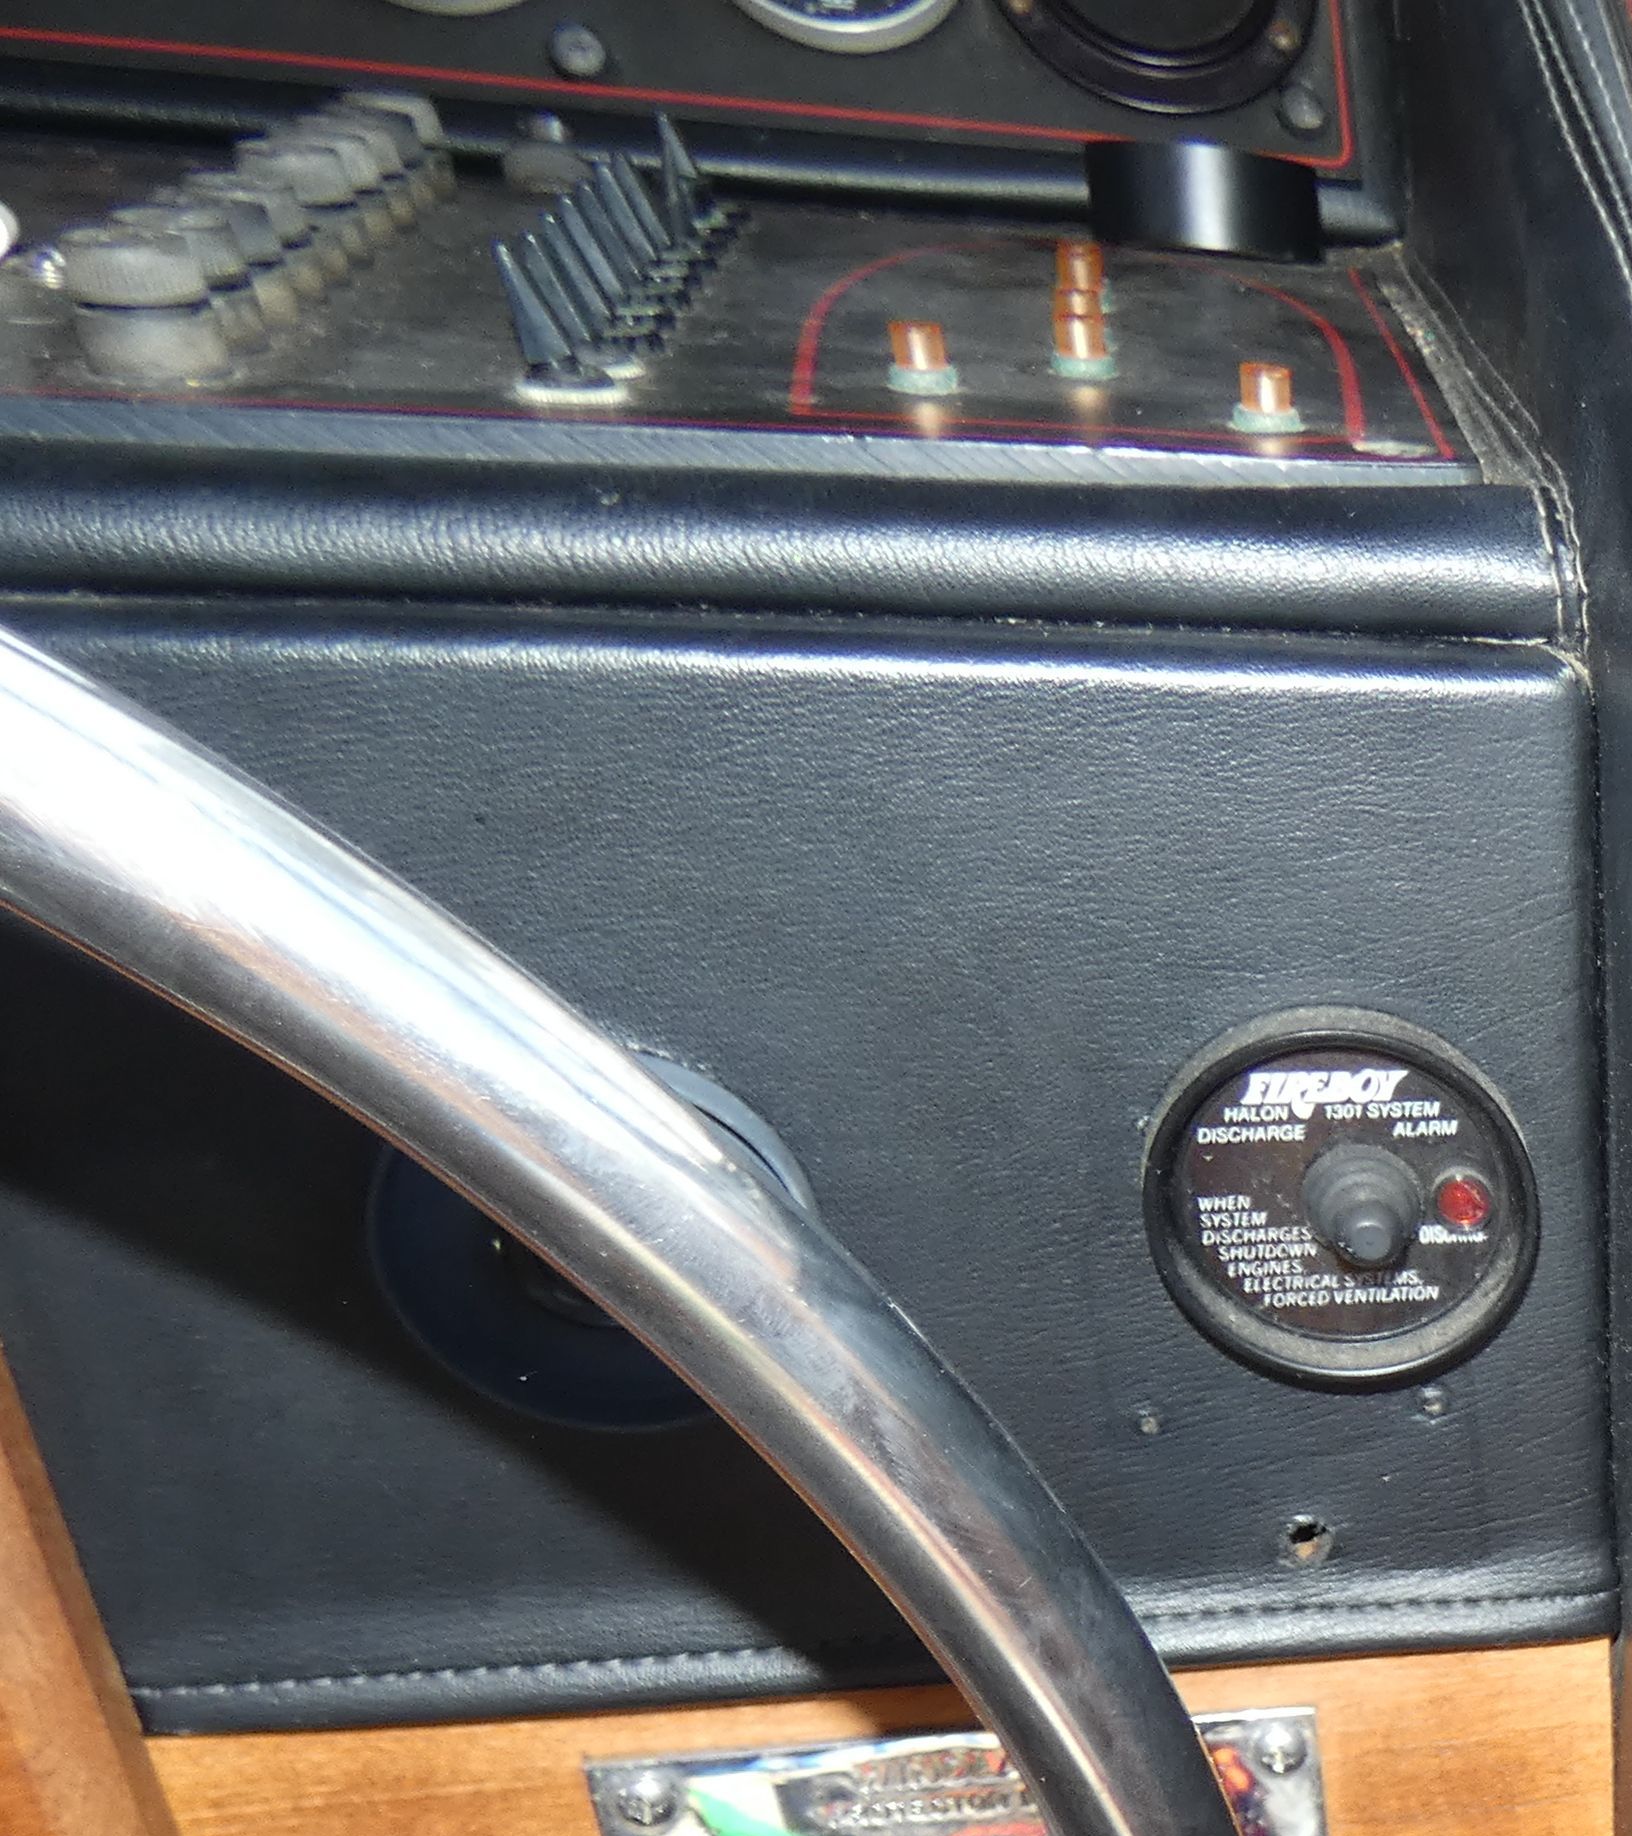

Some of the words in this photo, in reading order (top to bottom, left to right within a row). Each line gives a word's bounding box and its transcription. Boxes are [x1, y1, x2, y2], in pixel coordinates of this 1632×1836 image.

[1240, 1069, 1408, 1112] FIREBOY
[1224, 1105, 1289, 1123] HALON
[1324, 1104, 1362, 1120] 1301
[1366, 1101, 1441, 1119] SYSTEM
[1197, 1124, 1306, 1144] DISCHARGE
[1392, 1120, 1458, 1138] ALARM
[1197, 1195, 1251, 1211] WHEN
[1200, 1211, 1268, 1228] SYSTEM
[1202, 1226, 1312, 1245] DISCHARGES
[1217, 1244, 1318, 1261] SHUTDOWN
[1243, 1276, 1340, 1293] ELECTRICAL
[1264, 1291, 1331, 1308] FORCED
[1334, 1285, 1440, 1304] VENTILATION
